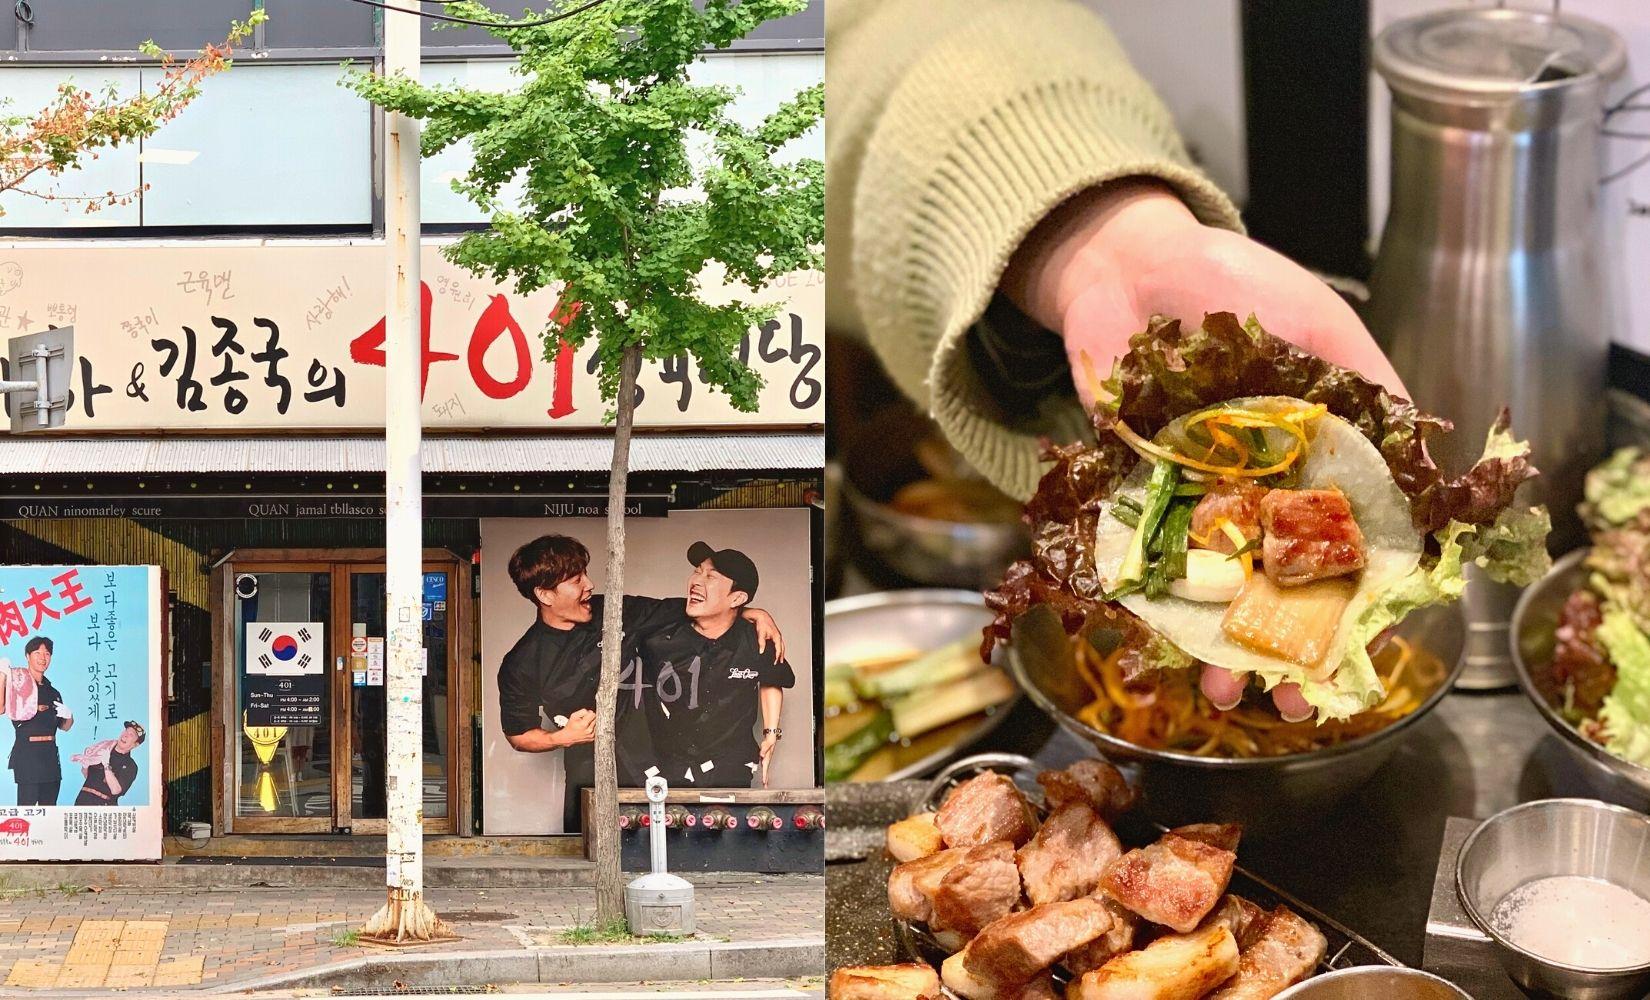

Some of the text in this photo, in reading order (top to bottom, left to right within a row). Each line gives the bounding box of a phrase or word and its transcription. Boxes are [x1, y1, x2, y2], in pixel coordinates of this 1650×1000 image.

[306, 275, 353, 330] 사랑해!
[126, 362, 150, 402] &
[151, 315, 347, 417] 김종국의
[18, 504, 162, 519] QUAN ninomarley scure
[248, 504, 289, 516] QUAN
[295, 503, 327, 517] jamal
[330, 503, 374, 515] tbllasco
[544, 503, 642, 516] NIJU noa sool
[0, 568, 93, 646] 肉大王
[87, 612, 101, 652] 보다
[104, 663, 118, 720] 고기로
[618, 655, 701, 711] 401
[24, 808, 46, 817] 고기
[14, 837, 30, 847] 401
